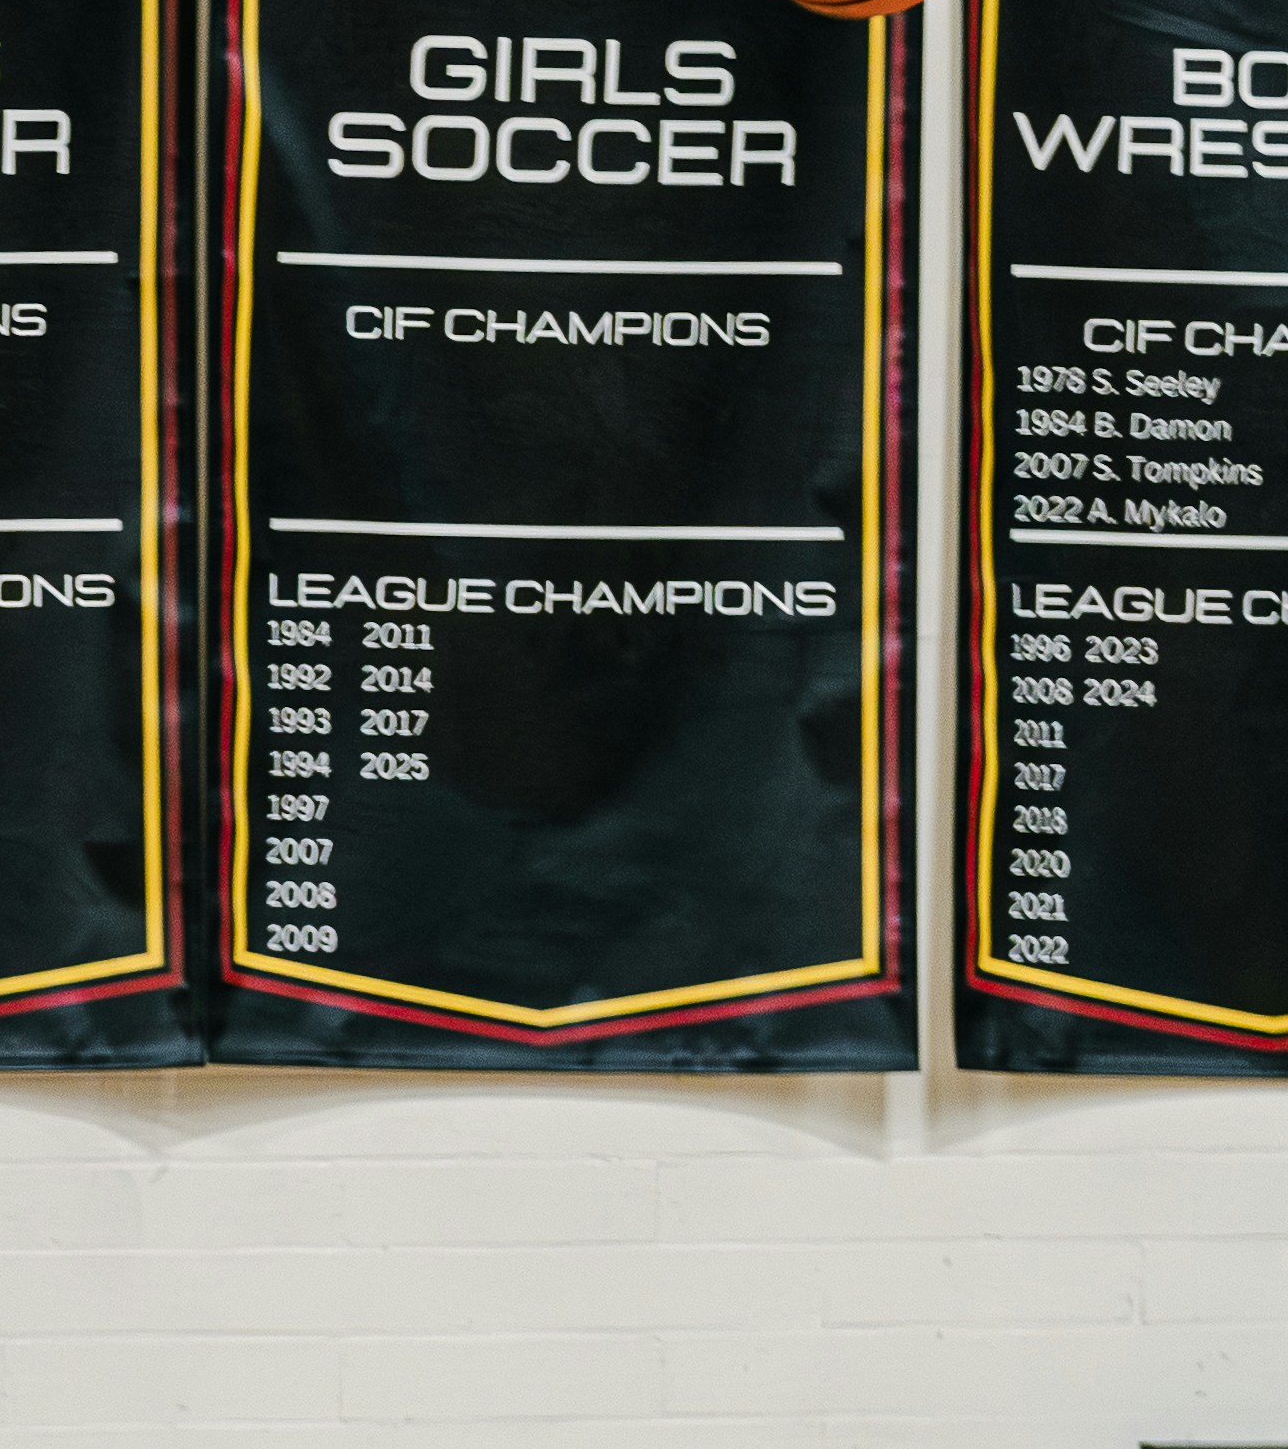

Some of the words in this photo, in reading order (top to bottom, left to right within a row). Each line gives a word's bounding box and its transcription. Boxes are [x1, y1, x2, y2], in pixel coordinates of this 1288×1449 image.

[409, 34, 737, 107] GIRLS
[327, 111, 797, 187] SOCCER
[345, 305, 435, 341] CIF
[444, 308, 771, 347] CHAMPIONS
[1083, 317, 1177, 354] CIF
[1013, 451, 1090, 480] 2007
[1092, 453, 1122, 482] S.
[1125, 455, 1264, 491] Tompkins
[1013, 494, 1084, 524] 2022
[1086, 497, 1118, 525] A.
[1124, 498, 1228, 533] Mykalo
[268, 572, 497, 614] LEAGUE
[505, 579, 837, 617] CHAMPIONS
[1011, 582, 1234, 625] LEAGUE
[266, 619, 333, 647] 1984
[361, 621, 435, 651] 2011
[1084, 635, 1159, 666] 2023
[266, 662, 332, 691] 1992
[360, 664, 435, 694] 2014
[1082, 677, 1158, 708] 2024
[268, 706, 333, 735] 1993
[359, 708, 430, 737] 2017
[268, 750, 333, 779] 1994
[359, 751, 430, 781] 2025
[266, 793, 330, 822] 1997
[265, 836, 334, 866] 2007
[265, 880, 337, 910] 2008
[266, 923, 339, 953] 2009
